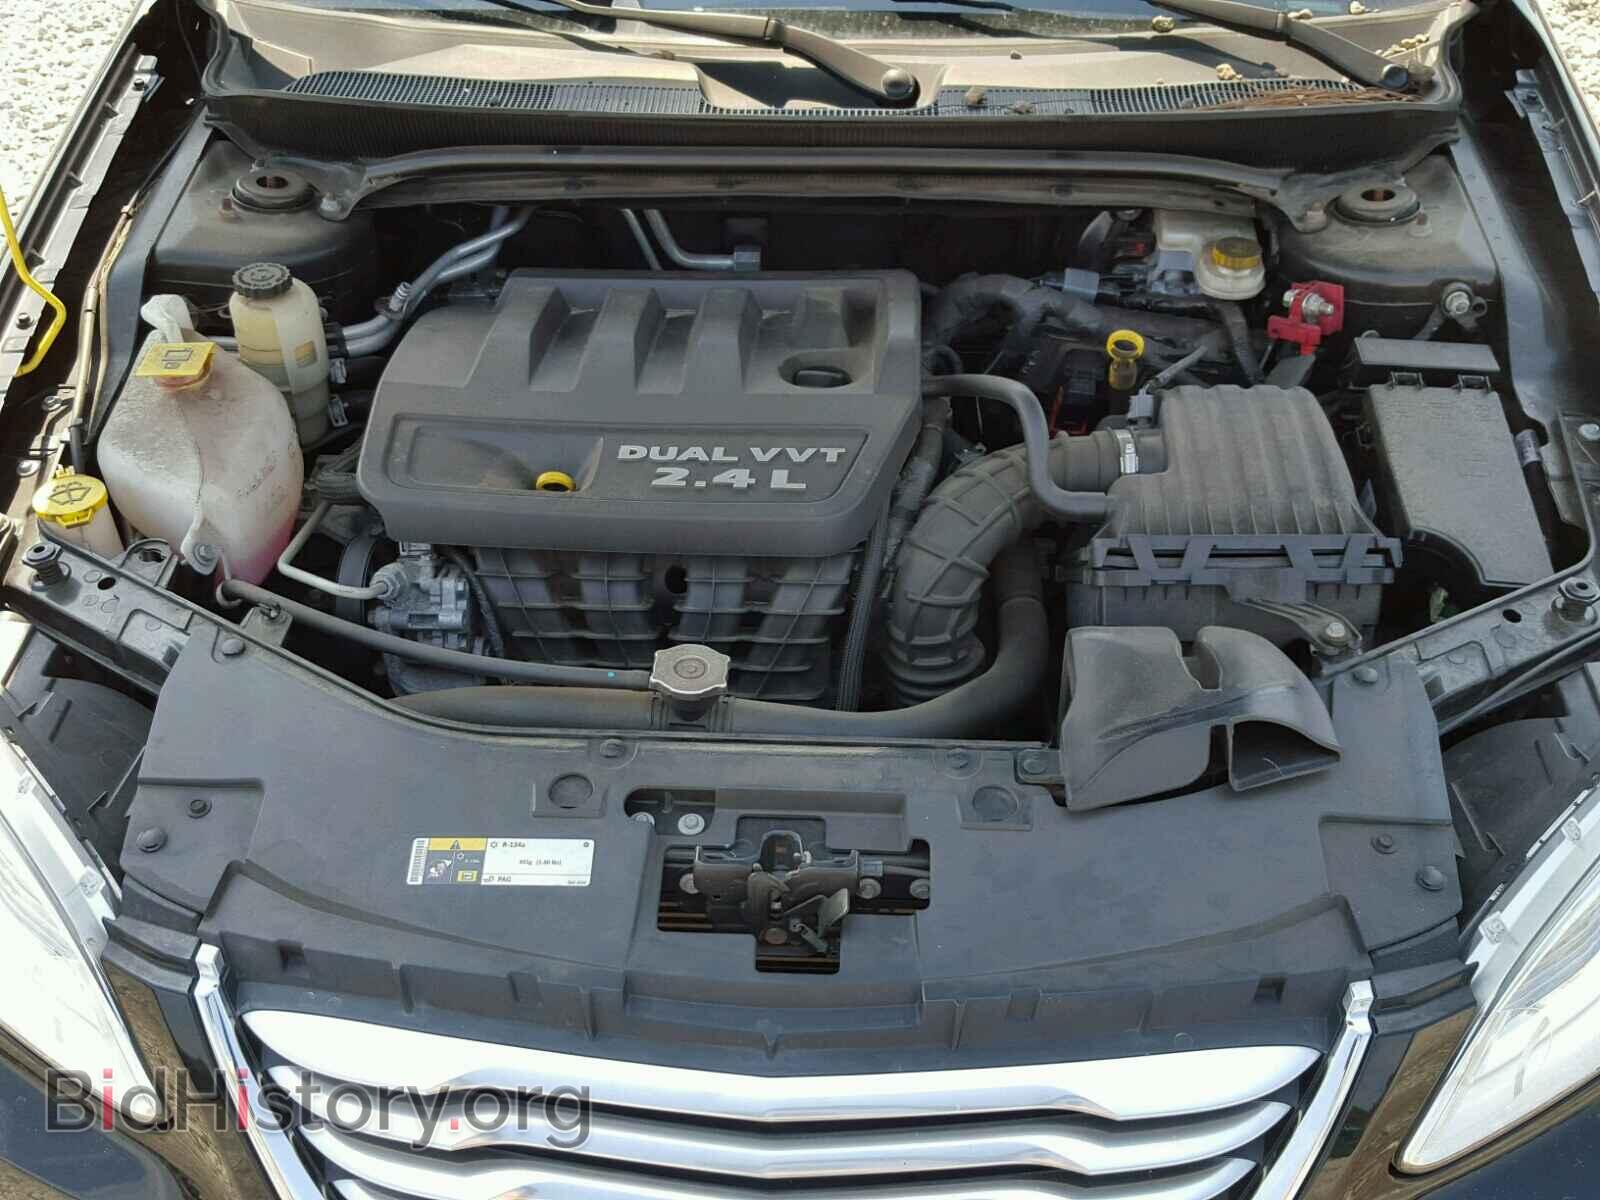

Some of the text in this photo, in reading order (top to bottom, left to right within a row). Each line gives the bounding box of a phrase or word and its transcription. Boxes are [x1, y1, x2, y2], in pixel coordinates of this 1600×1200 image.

[616, 445, 847, 463] DUAL VVT
[650, 467, 807, 489] 2.4 L
